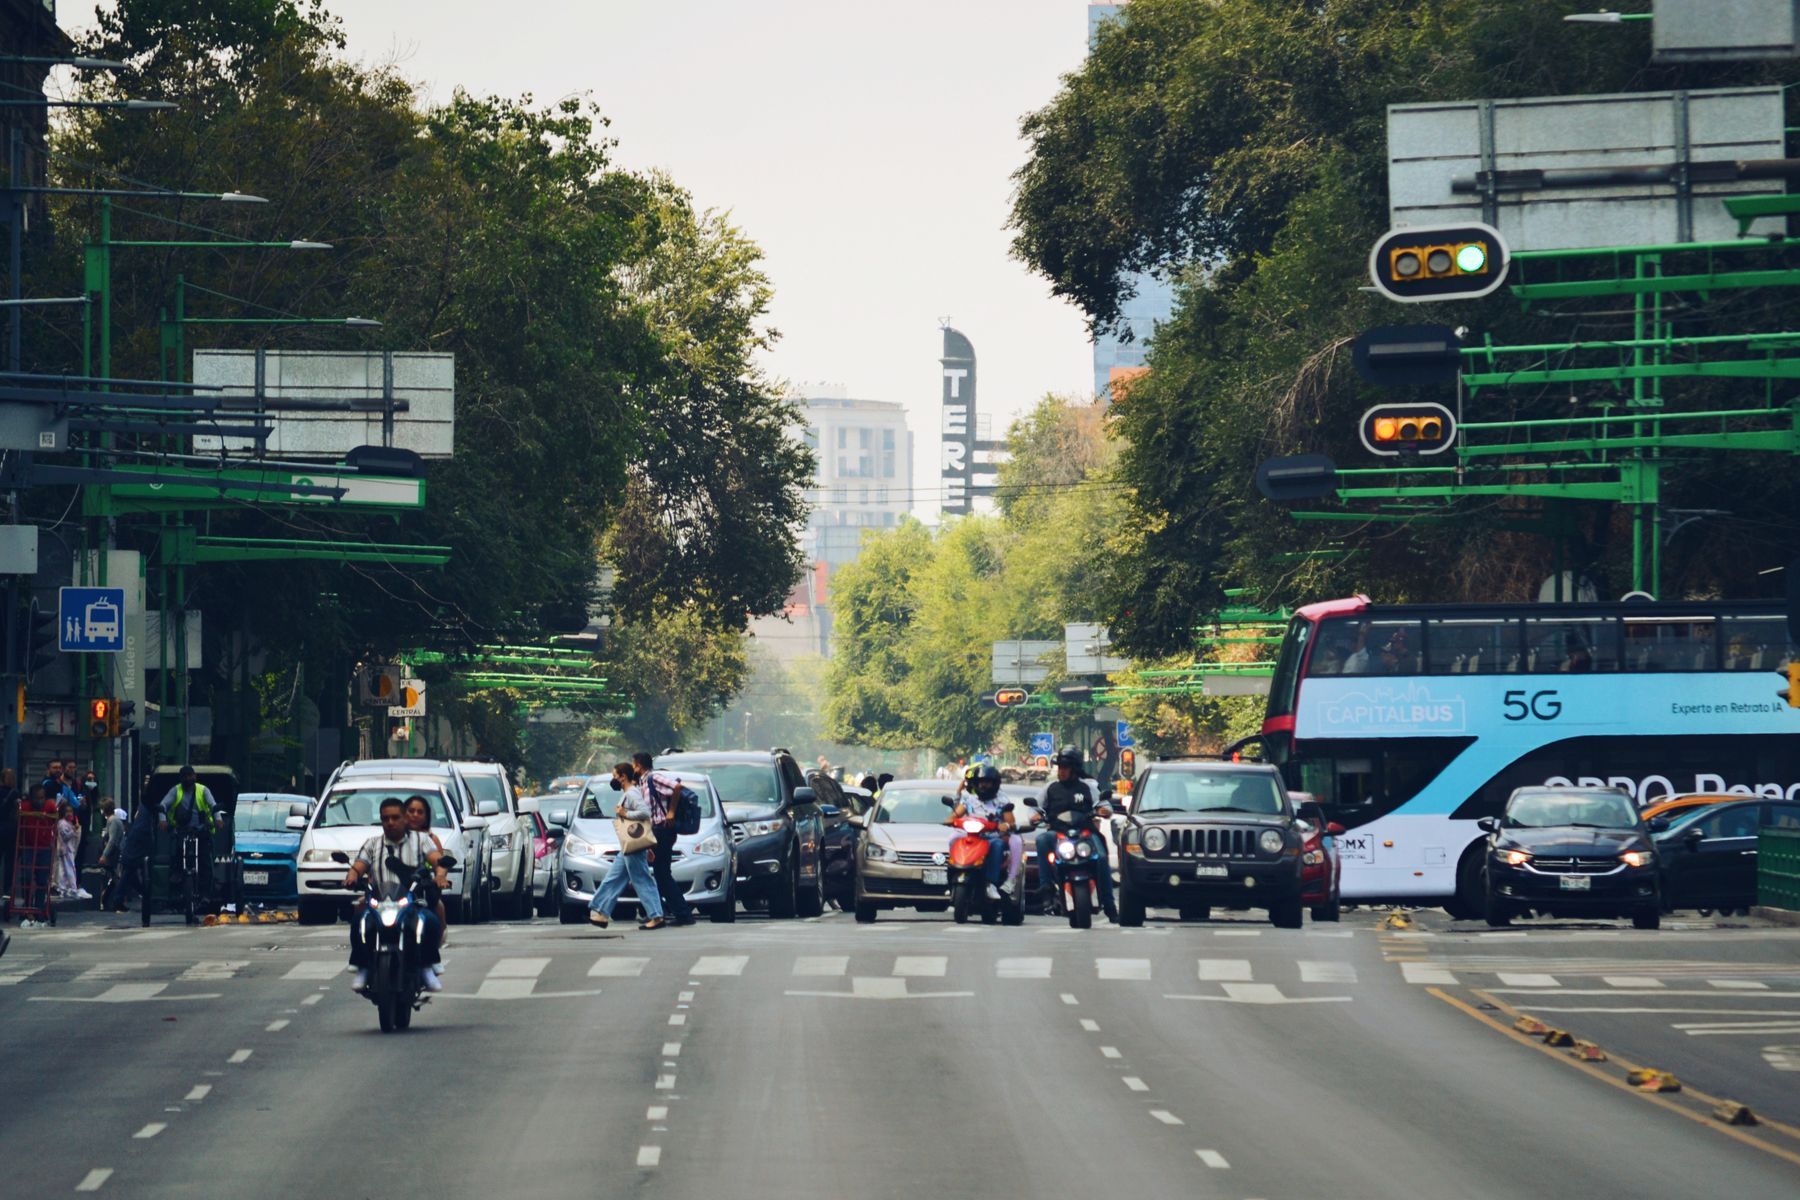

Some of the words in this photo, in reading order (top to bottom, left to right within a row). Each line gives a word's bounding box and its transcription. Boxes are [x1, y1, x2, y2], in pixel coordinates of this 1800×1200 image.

[942, 368, 967, 517] TERE
[124, 635, 136, 690] Madero
[391, 708, 422, 716] CENTRAL
[1326, 704, 1454, 724] CAPITALBUS
[1503, 689, 1563, 721] 5G
[1671, 702, 1712, 716] Experto
[1714, 704, 1728, 713] en
[1730, 702, 1770, 713] Retrato
[1771, 701, 1784, 713] IA
